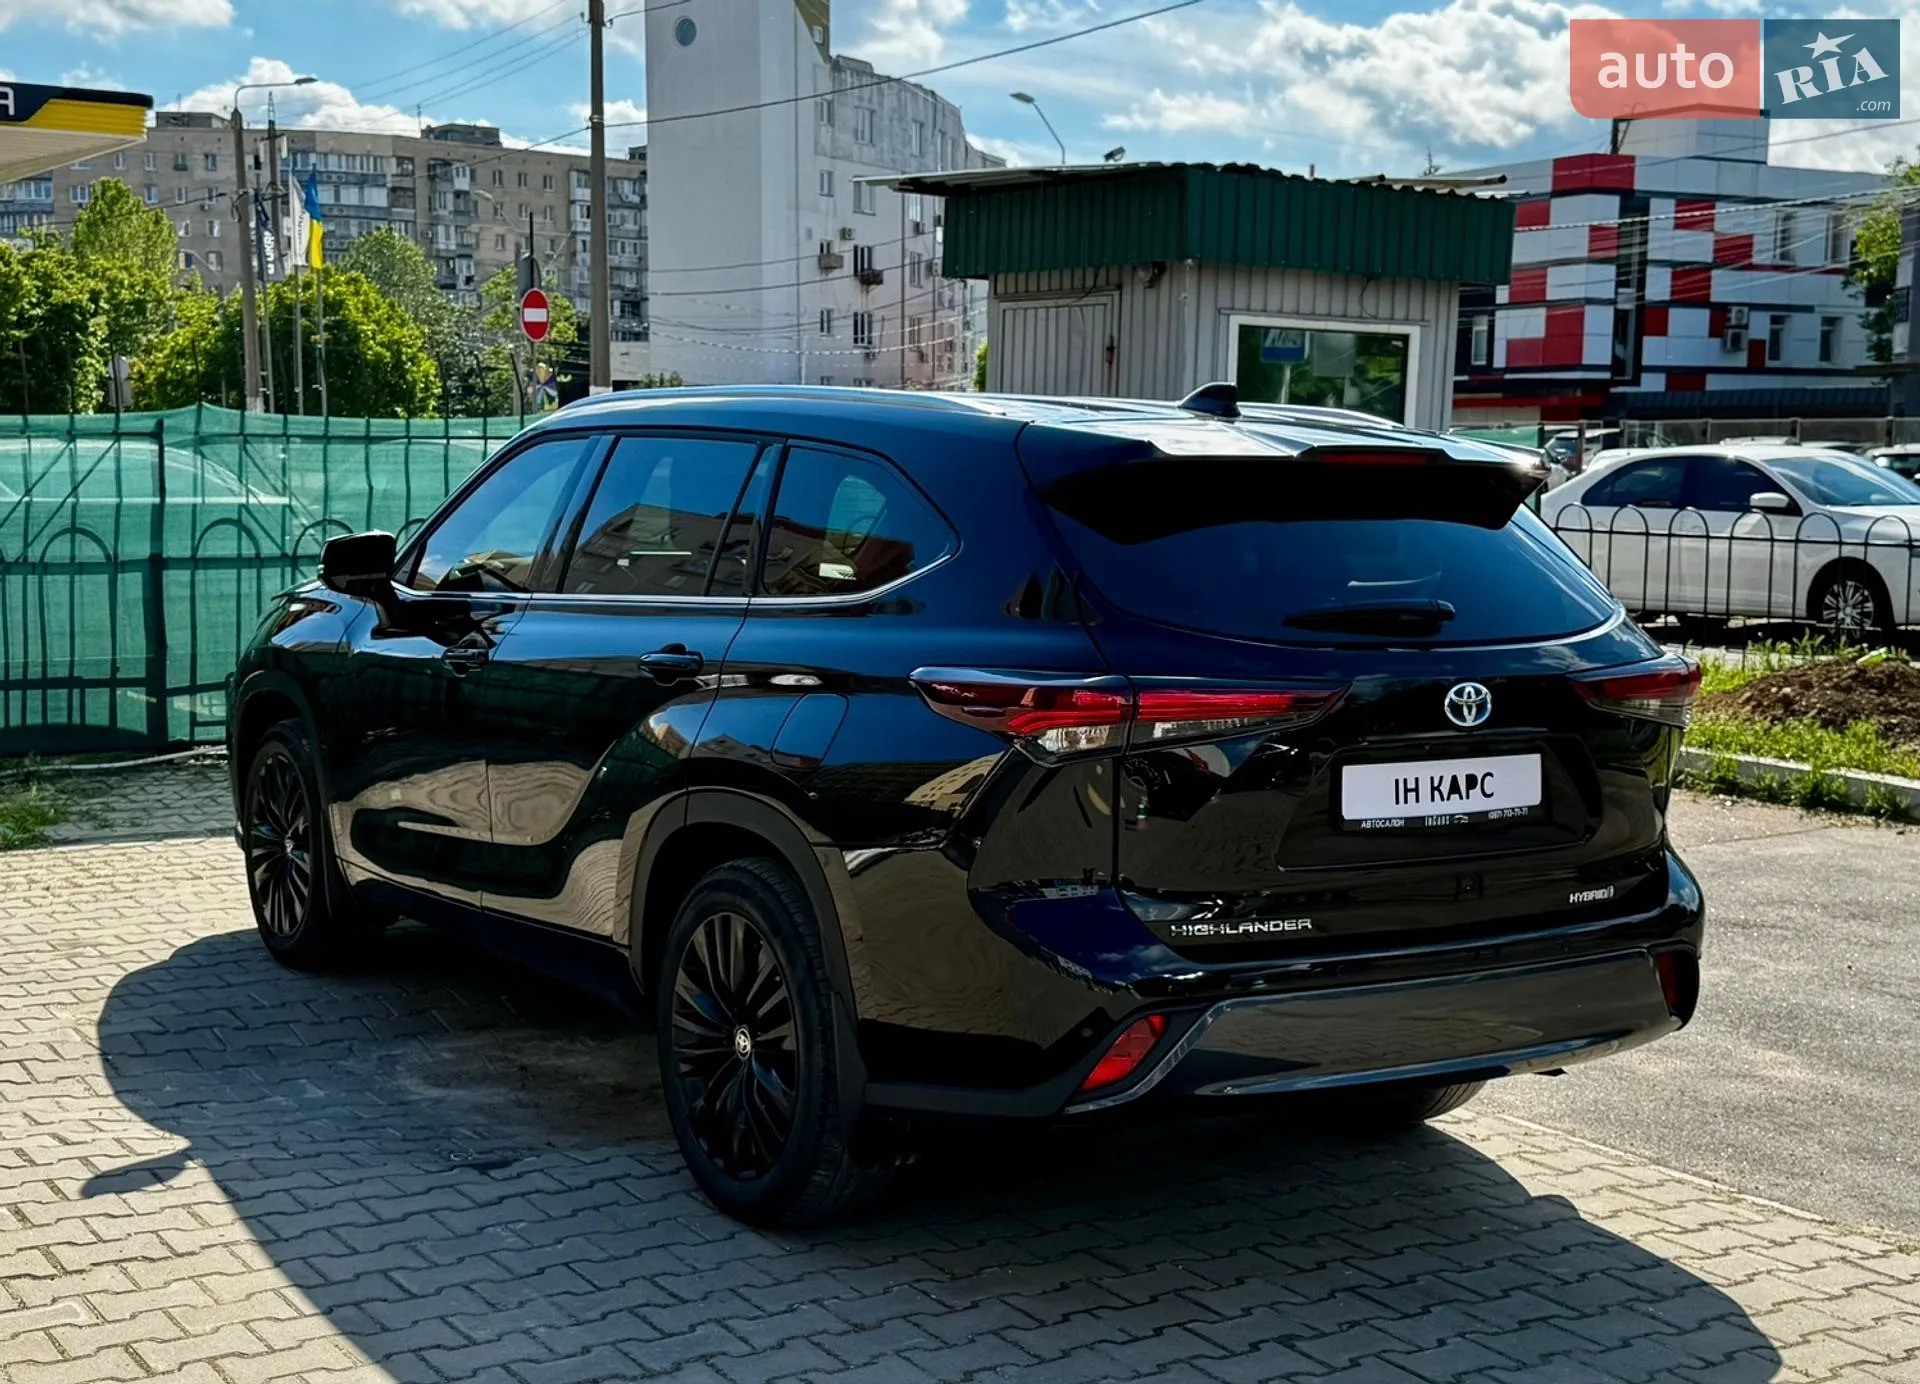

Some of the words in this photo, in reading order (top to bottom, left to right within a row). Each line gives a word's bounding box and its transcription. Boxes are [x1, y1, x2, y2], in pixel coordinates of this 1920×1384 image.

[1394, 776, 1421, 806] ІН
[1430, 771, 1495, 803] КАРС
[1360, 818, 1405, 829] АВТОСАЛОН
[1569, 888, 1609, 904] HYBRID
[1170, 918, 1313, 937] HIGHLANDER
